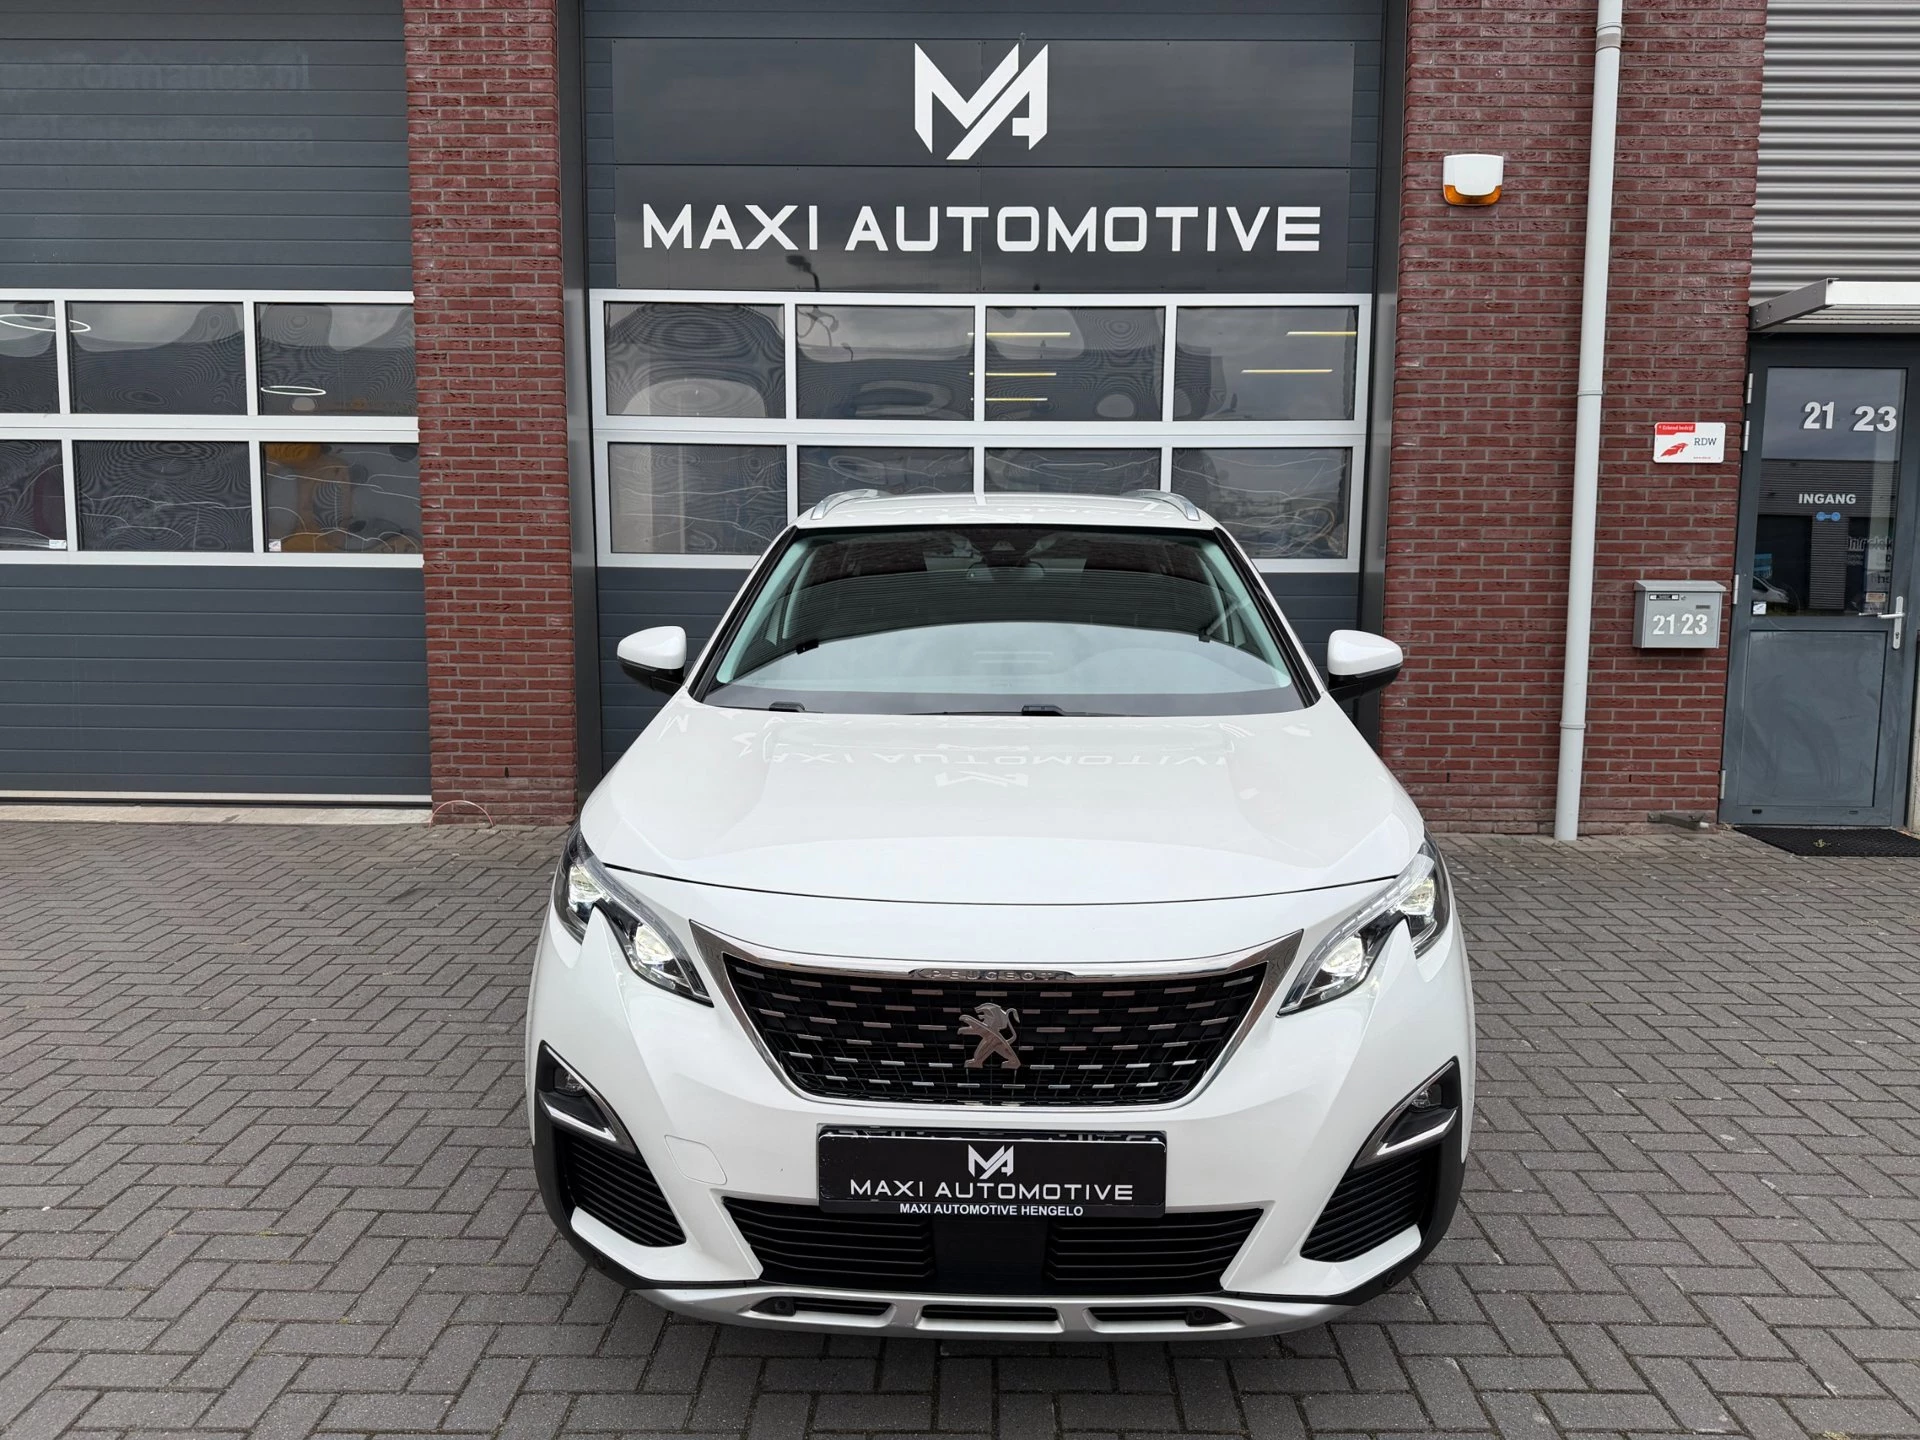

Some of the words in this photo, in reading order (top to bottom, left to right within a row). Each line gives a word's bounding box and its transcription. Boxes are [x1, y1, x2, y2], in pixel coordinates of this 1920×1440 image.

[642, 203, 818, 251] MAXI
[845, 205, 1321, 253] AUTOMOTIVE
[1803, 401, 1835, 430] 21
[1853, 405, 1897, 432] 23
[1694, 437, 1717, 446] RDW
[1798, 493, 1856, 505] INGANG
[1652, 613, 1676, 635] 21
[1680, 613, 1708, 635] 23
[930, 969, 1053, 981] PEUGEOT
[850, 1179, 924, 1197] MAXI
[935, 1181, 1133, 1201] AUTOMOTIVE
[899, 1203, 931, 1214] MAXI
[933, 1203, 1018, 1216] AUTOMOTIVE
[1021, 1205, 1084, 1217] HENGELO
